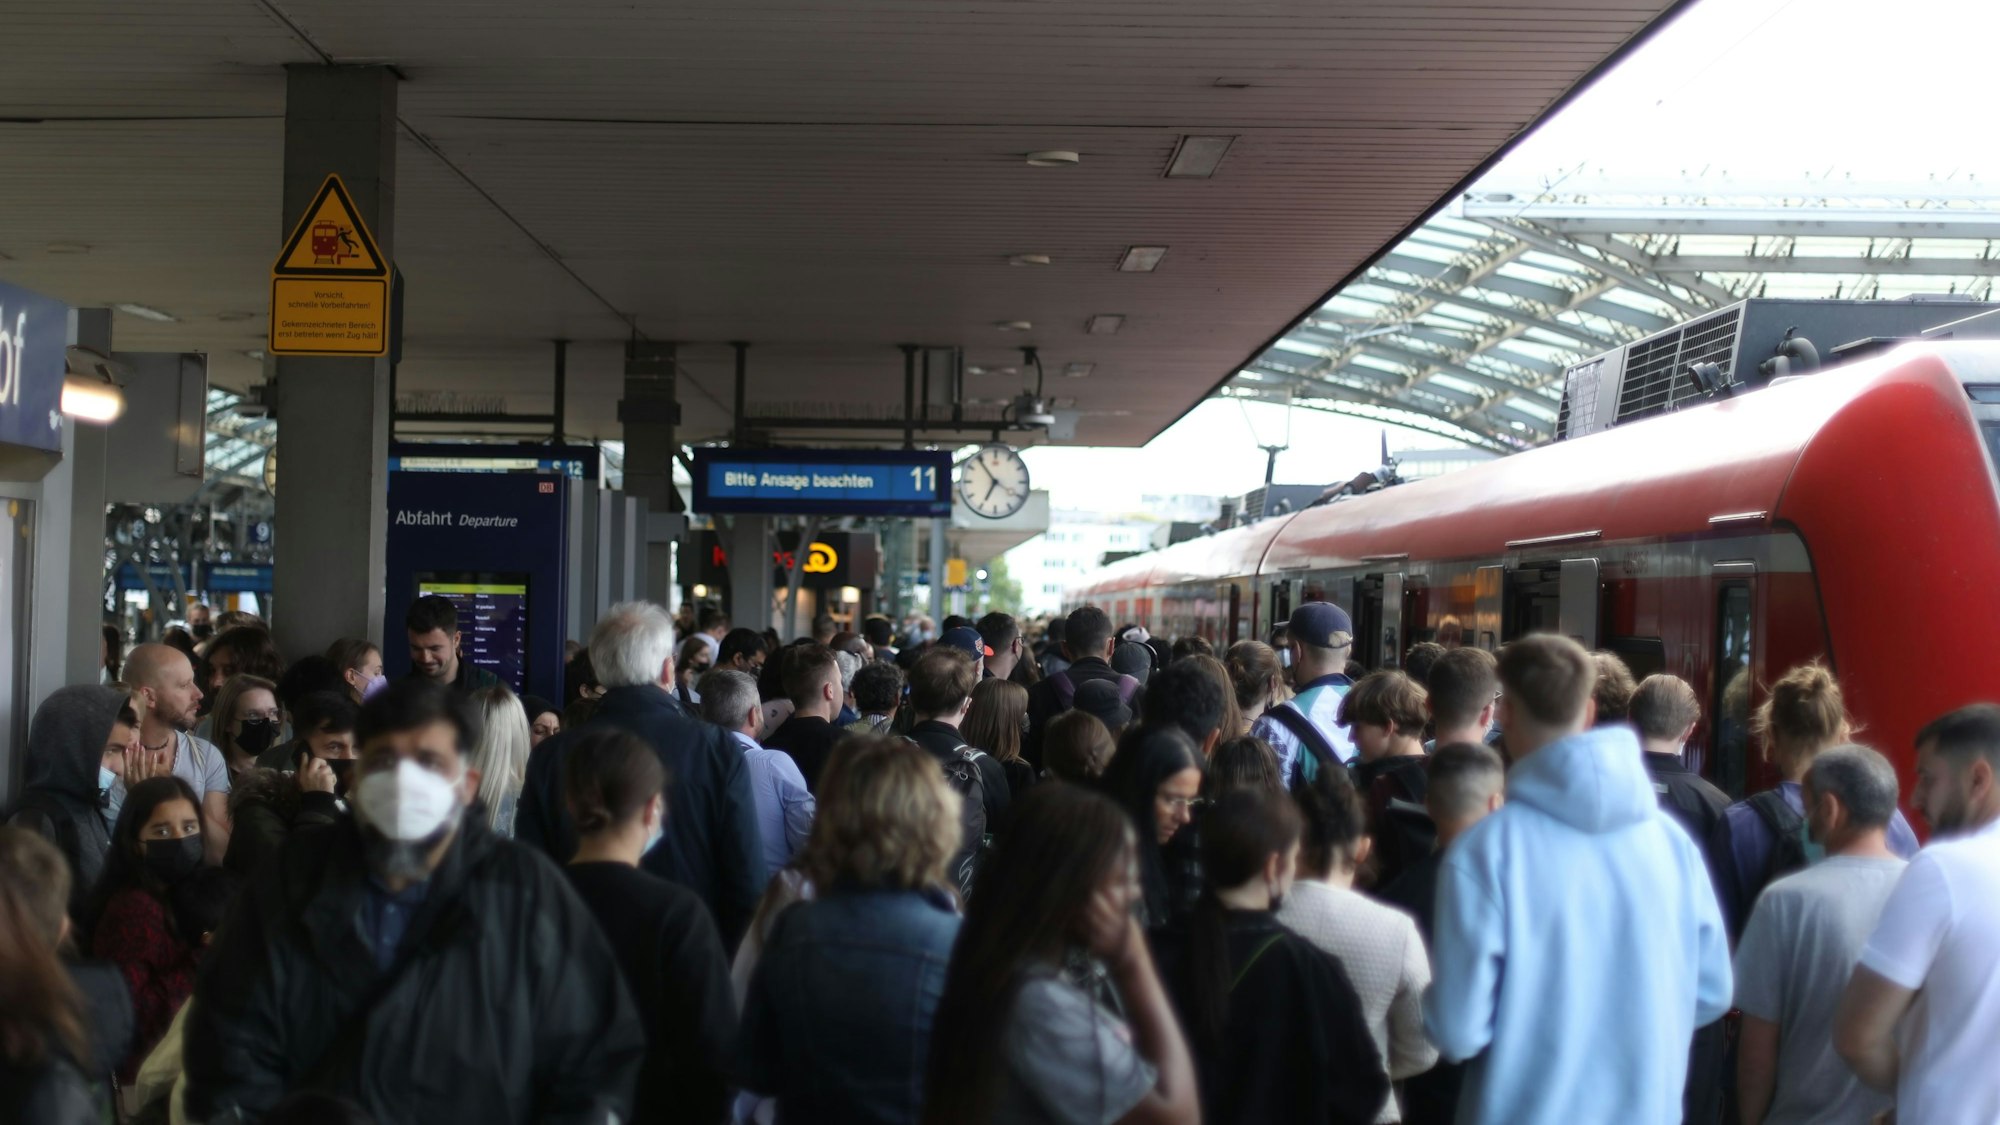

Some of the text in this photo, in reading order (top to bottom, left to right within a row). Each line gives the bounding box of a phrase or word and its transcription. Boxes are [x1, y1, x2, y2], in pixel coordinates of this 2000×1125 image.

[288, 301, 319, 309] schnelle
[281, 320, 376, 329] Gekennzeichneten Bereich
[278, 331, 292, 339] erst
[294, 331, 325, 339] betreten
[325, 332, 346, 340] wenn
[346, 332, 360, 340] Zug
[567, 460, 584, 476] 12
[724, 466, 937, 492] Bitte Ansage beachten 11
[539, 482, 553, 493] DB
[395, 509, 519, 529] Abfahrt Departure
[255, 522, 270, 541] 9
